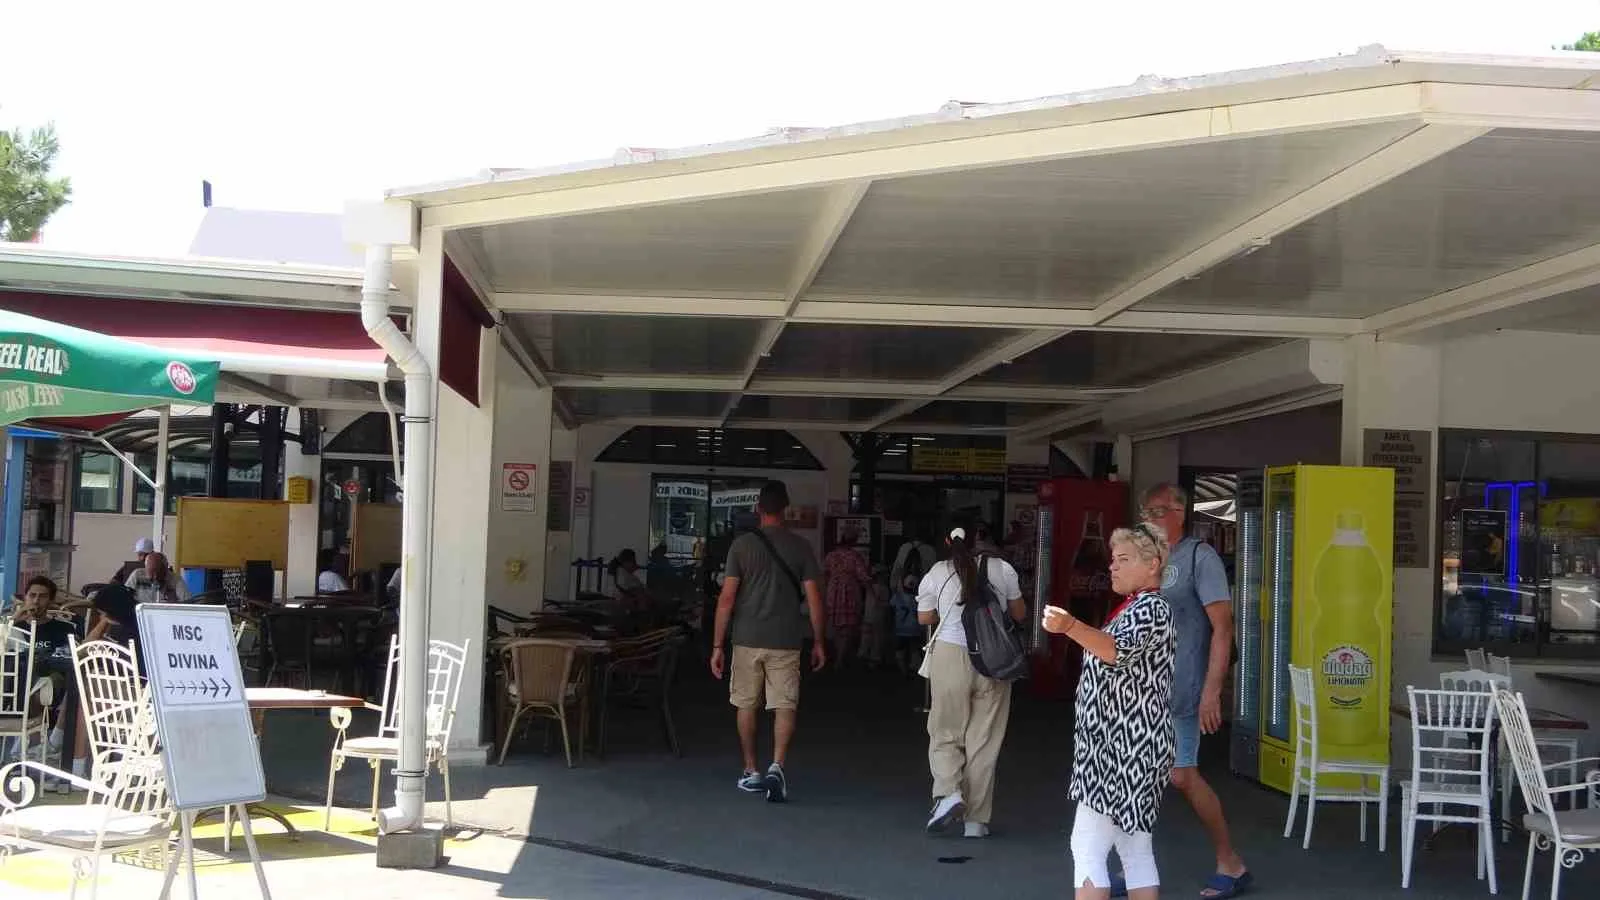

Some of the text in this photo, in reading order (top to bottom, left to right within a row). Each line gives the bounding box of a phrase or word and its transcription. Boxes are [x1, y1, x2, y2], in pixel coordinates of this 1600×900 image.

[24, 345, 63, 375] REAL
[172, 625, 203, 641] MSC
[168, 653, 219, 669] DIVINA
